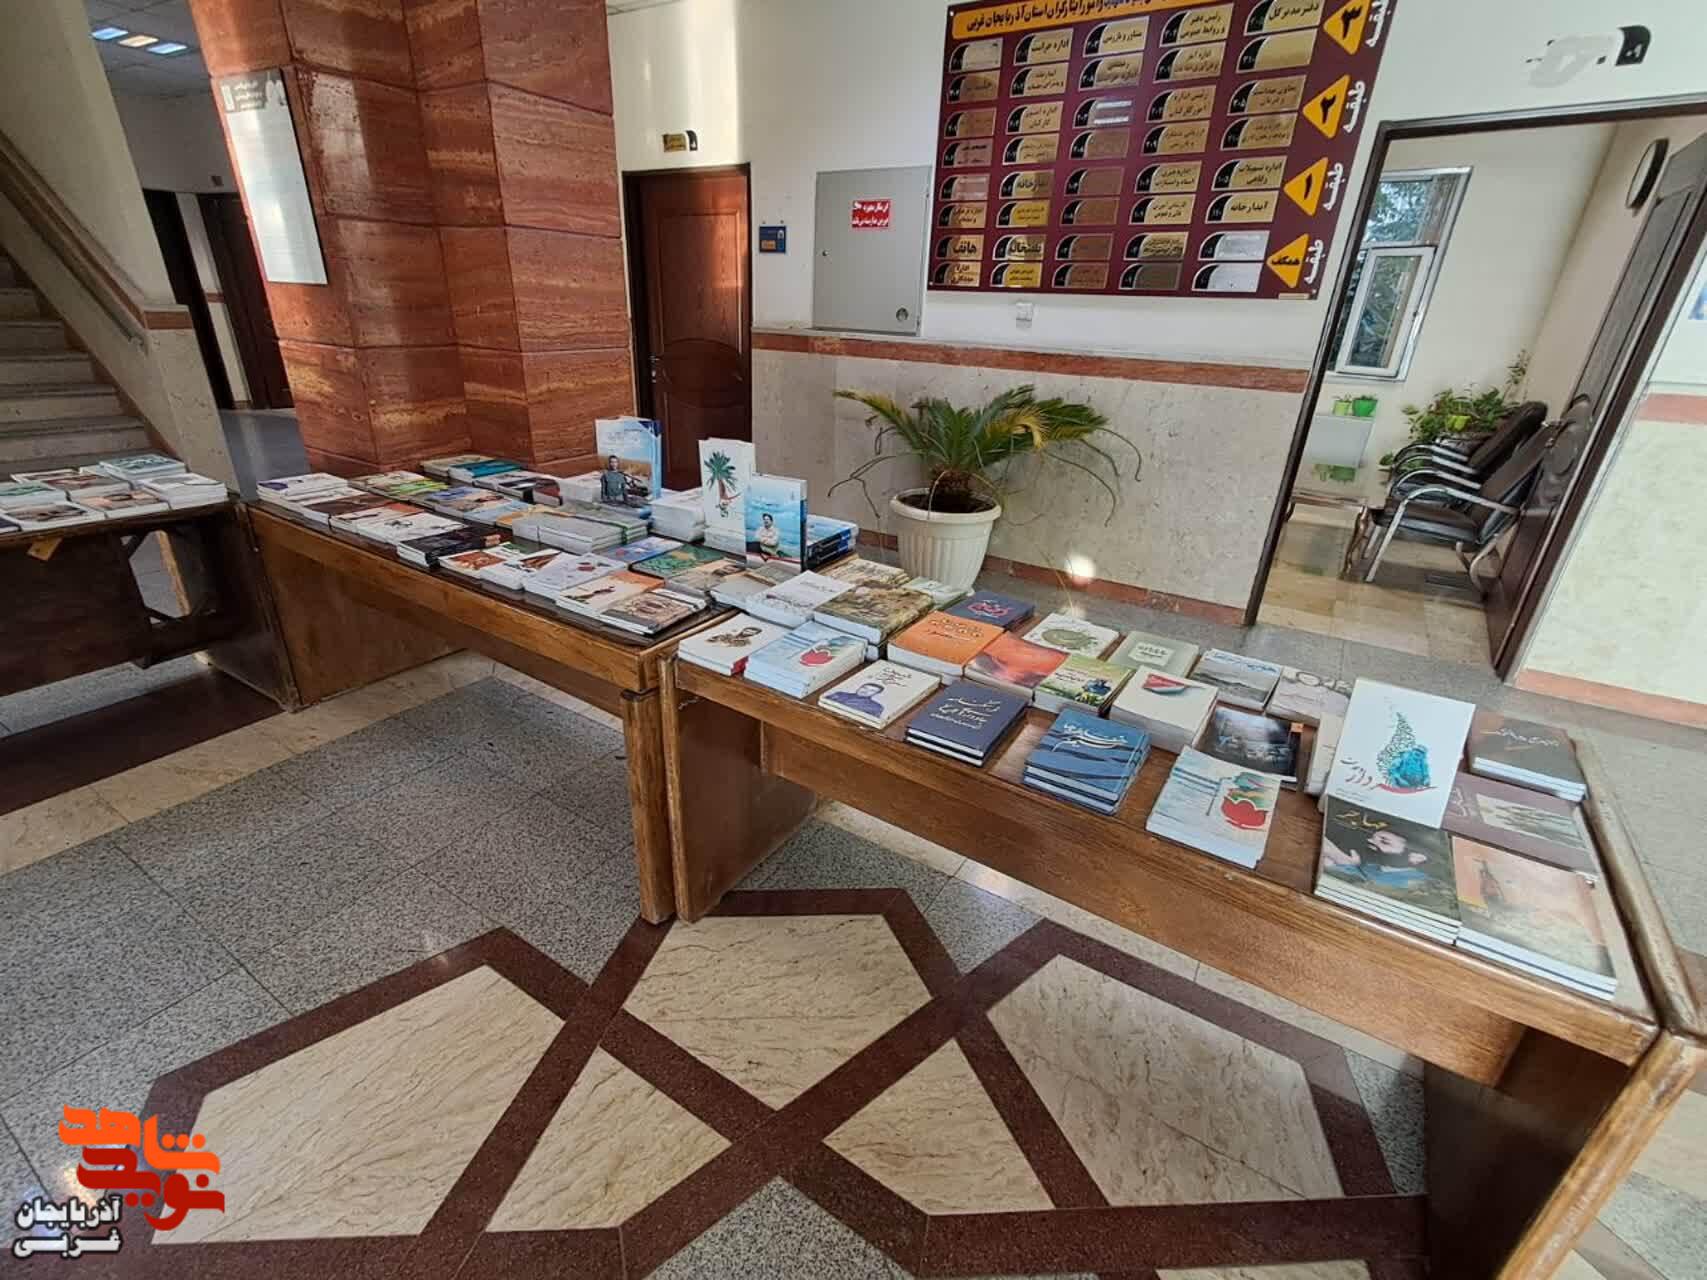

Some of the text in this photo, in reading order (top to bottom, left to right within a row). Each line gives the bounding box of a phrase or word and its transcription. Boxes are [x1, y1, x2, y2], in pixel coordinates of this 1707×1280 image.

[966, 13, 985, 32] غربی
[985, 4, 1026, 28] آذربایجان
[1024, 3, 1048, 22] استان
[1341, 6, 1363, 39] ۳
[1320, 95, 1337, 124] ۲
[1343, 80, 1367, 134] طبقه
[1303, 174, 1313, 200] ۱
[1323, 162, 1345, 211] طبقه
[1304, 240, 1326, 285] طبقه
